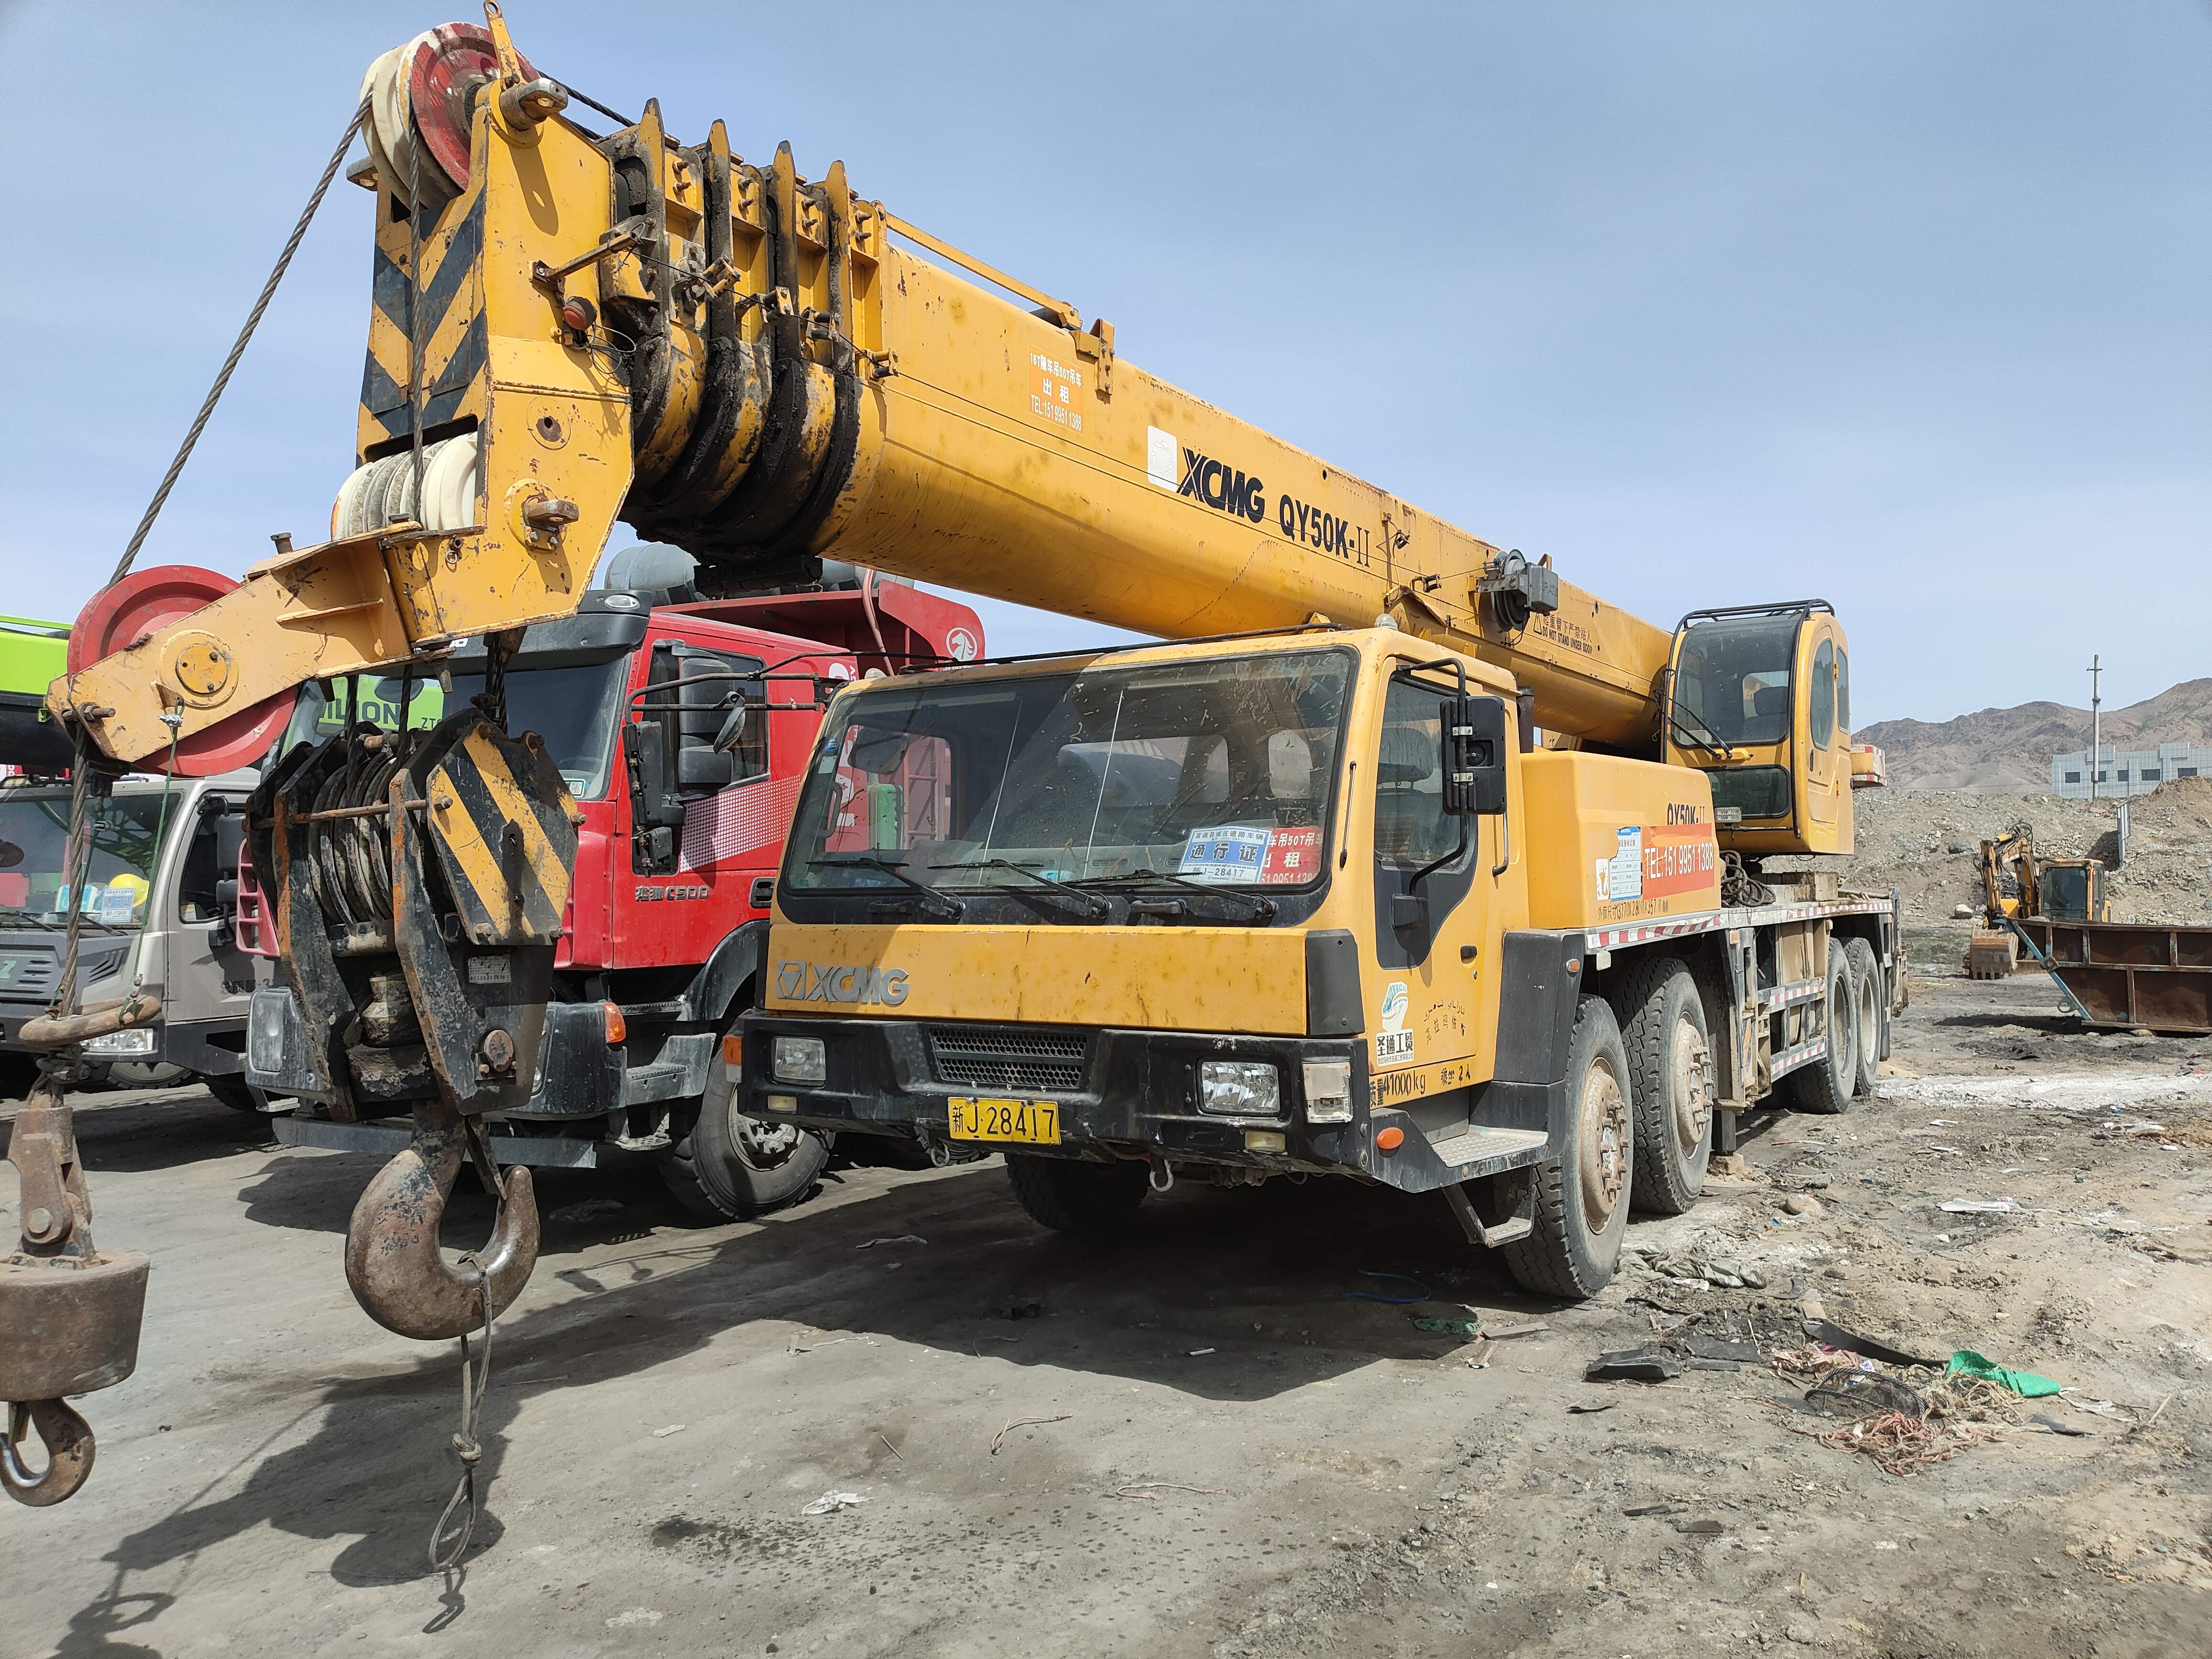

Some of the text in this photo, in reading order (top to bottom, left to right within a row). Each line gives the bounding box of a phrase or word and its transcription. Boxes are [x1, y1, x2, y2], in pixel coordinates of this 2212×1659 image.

[1030, 353, 1082, 387] 16T随车吊50T吊车
[1055, 405, 1068, 425] 9951
[1069, 411, 1082, 431] 1388
[1177, 447, 1265, 523] XCMG
[1542, 626, 1548, 637] DO
[1558, 632, 1570, 646] STAND
[1190, 842, 1258, 862] 通行证
[1679, 843, 1695, 874] 9951
[1698, 841, 1714, 872] 1388
[665, 885, 709, 900] C500
[804, 965, 910, 1006] XCMG
[1377, 1032, 1413, 1057] 圣通工贸
